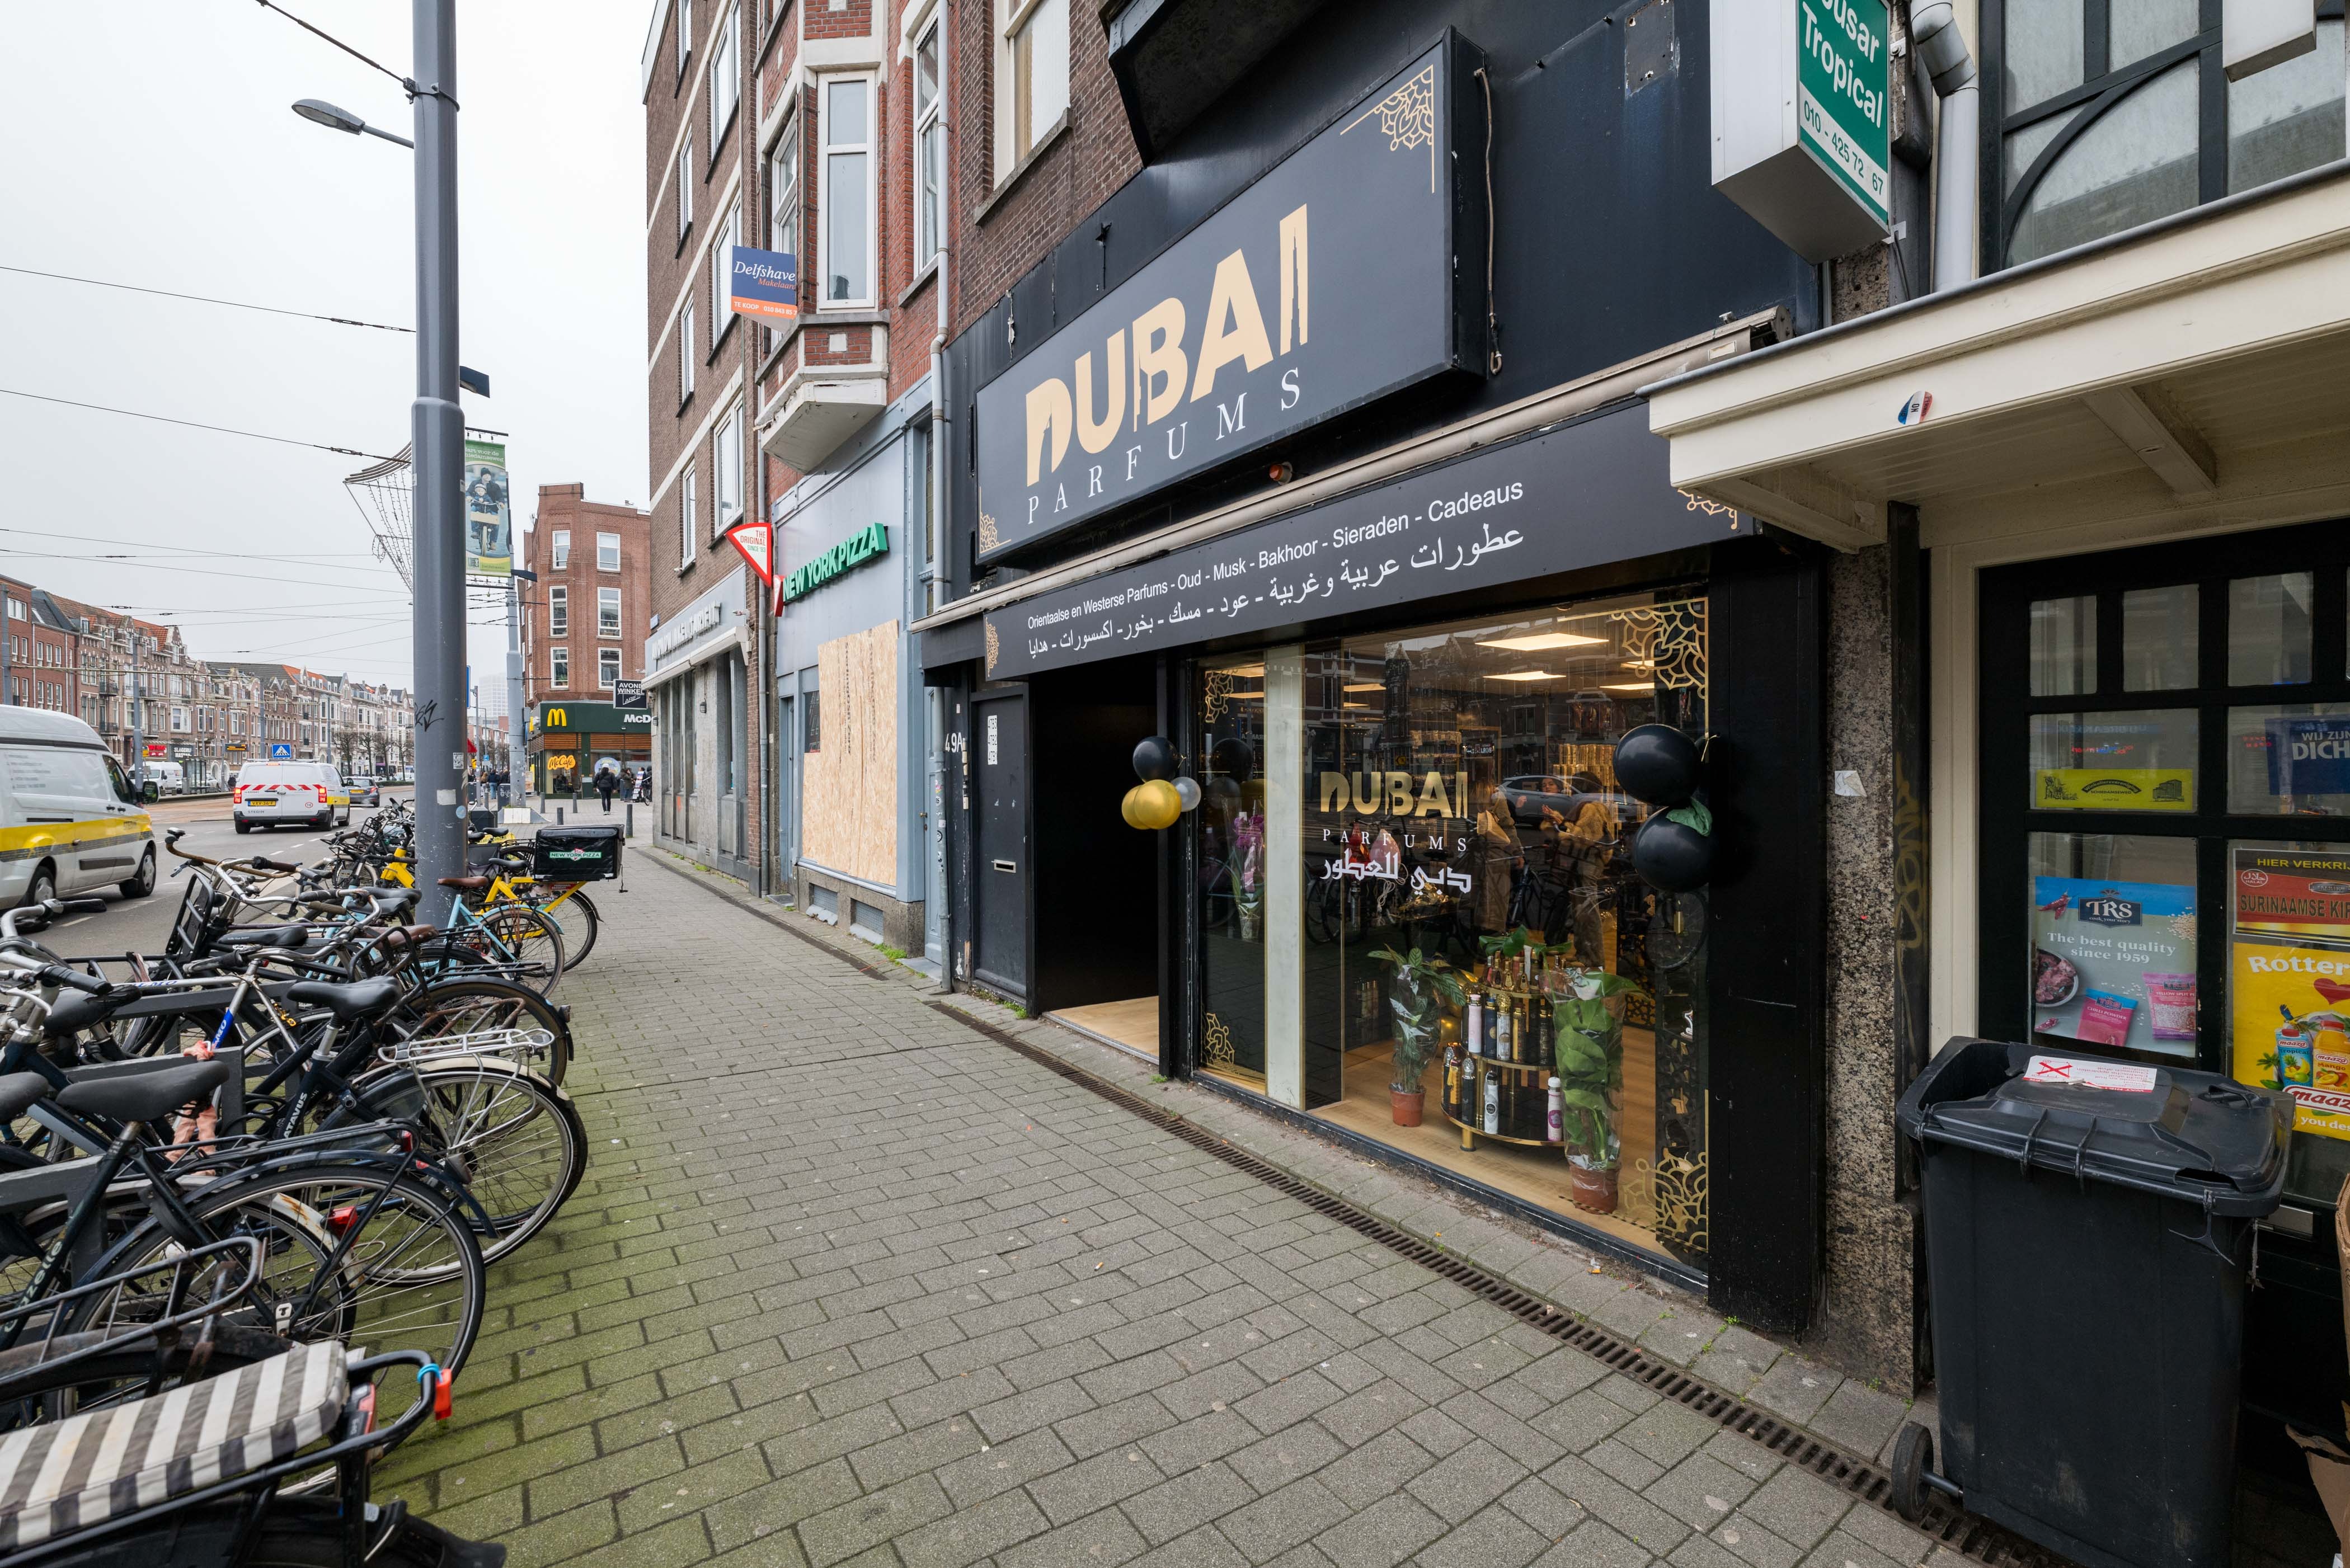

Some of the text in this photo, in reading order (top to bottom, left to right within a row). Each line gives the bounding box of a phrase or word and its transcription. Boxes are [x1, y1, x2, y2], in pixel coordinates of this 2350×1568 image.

[1803, 2, 1882, 128] Tropical
[1804, 100, 1821, 133] 010
[1831, 132, 1849, 163] 425
[1853, 150, 1864, 178] 72
[1872, 173, 1883, 195] 67
[734, 261, 796, 281] Delfshave
[1026, 204, 1308, 487] DUBAI
[1028, 368, 1300, 525] PARFUMS
[466, 453, 504, 462] hiedamseweg
[740, 535, 766, 547] ORIGINAL
[756, 530, 766, 539] THE
[1027, 610, 1069, 629] Orientaalse
[1071, 607, 1082, 618] en
[1083, 594, 1125, 615] Westerse
[1127, 580, 1168, 603] Parfums
[1177, 571, 1201, 590] Oud
[1214, 556, 1247, 581] Musk
[1258, 539, 1318, 569] Bakhoor
[1333, 514, 1409, 548] Sieraden
[1428, 482, 1524, 522] Cadeaus
[1411, 524, 1524, 571] عطورات
[783, 522, 884, 602] NEW YORK PIZZA
[1340, 559, 1399, 590] عربية
[1169, 602, 1201, 623] مسك
[1220, 594, 1249, 617] عود
[1123, 613, 1153, 641] بخور
[1028, 639, 1048, 660] هدايا
[623, 714, 652, 723] McD
[945, 732, 963, 753] 49A
[2301, 732, 2323, 741] WIJ
[548, 756, 574, 768] McCafé
[1320, 771, 1468, 818] DUBAI
[1323, 829, 1467, 852] PARFUMS
[1320, 847, 1472, 895] دبي للعطور
[2257, 858, 2289, 867] HIER
[2244, 872, 2266, 880] حلال
[2086, 900, 2132, 919] TRS
[2240, 894, 2325, 917] SURINAAMSE
[2047, 933, 2176, 957] The best quality
[2071, 947, 2150, 963] since 1959
[2104, 1011, 2127, 1020] POWDER
[2317, 1055, 2346, 1063] maaza
[284, 1092, 307, 1138] ATAVUS
[2301, 1116, 2326, 1128] you
